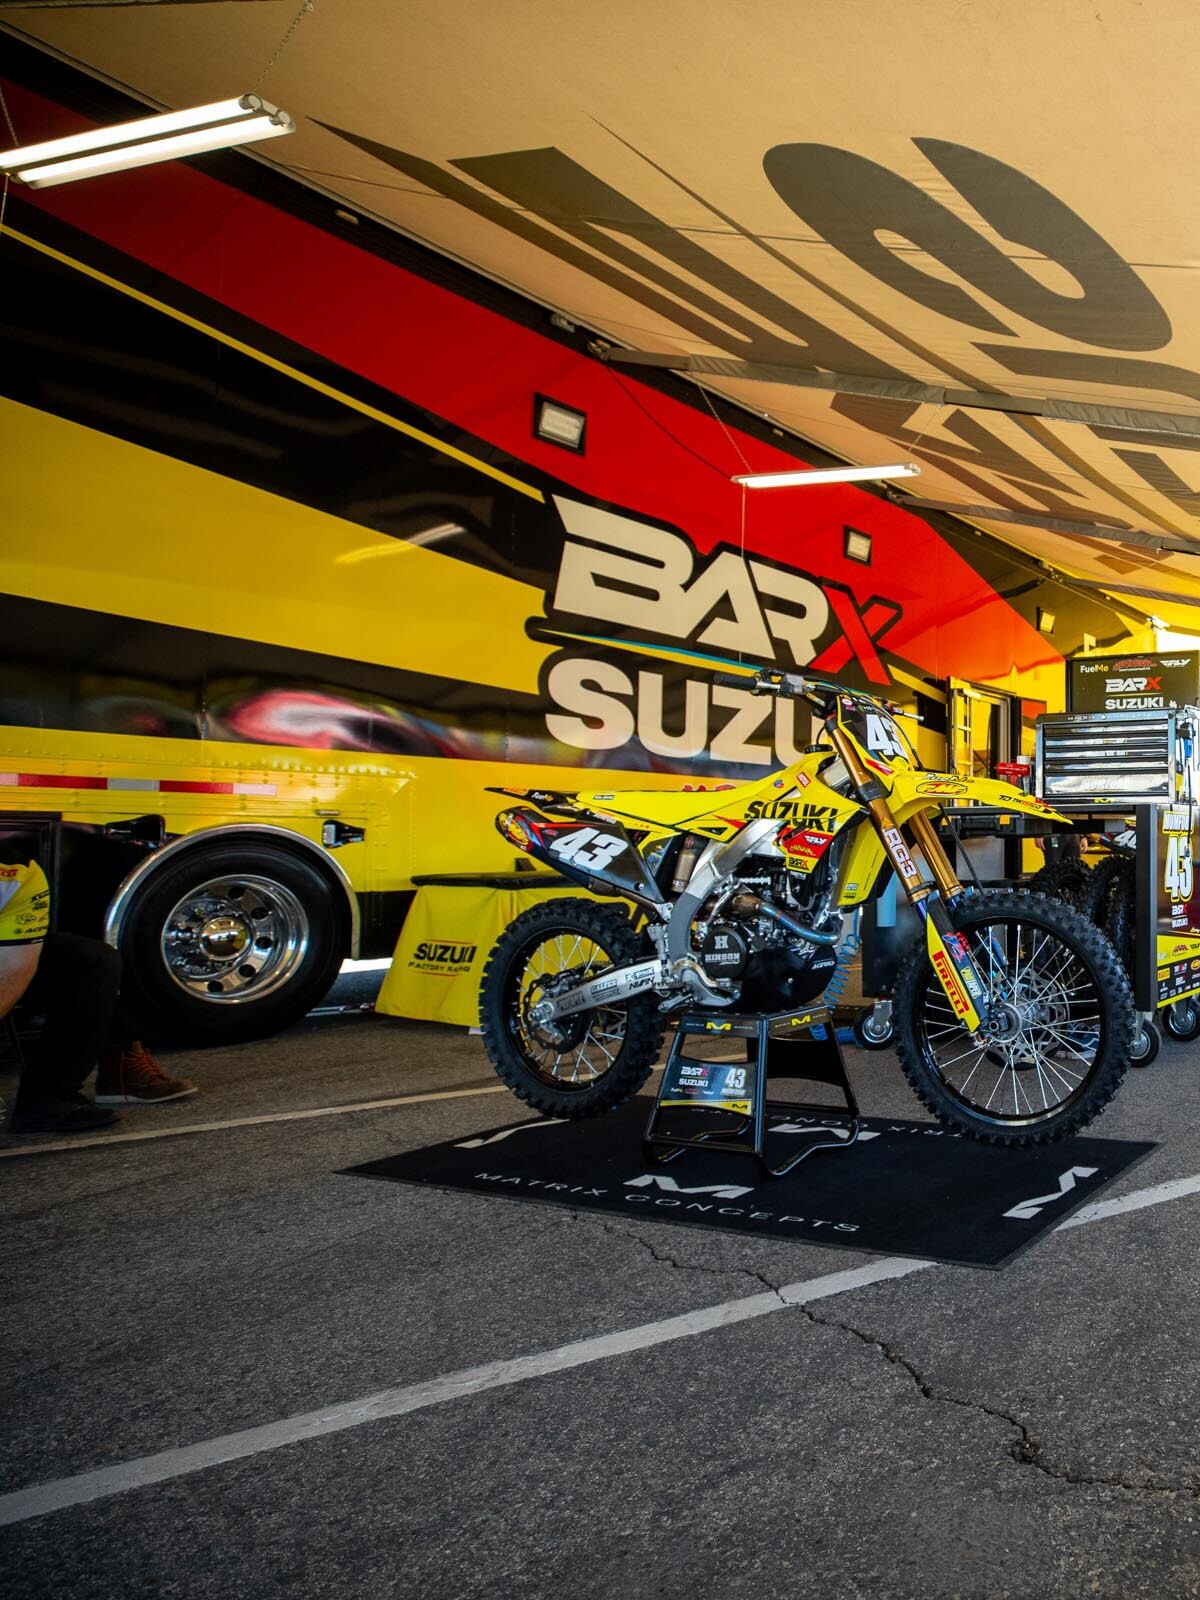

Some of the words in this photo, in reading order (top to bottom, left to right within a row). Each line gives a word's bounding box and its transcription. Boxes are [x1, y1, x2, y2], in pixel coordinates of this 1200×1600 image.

[551, 494, 902, 687] BARX
[1080, 664, 1109, 673] FuelMe
[1105, 676, 1163, 692] BARX
[1105, 697, 1163, 710] SUZUKI
[744, 800, 838, 833] SUZUKI
[550, 827, 628, 871] 43
[882, 827, 917, 879] RG3
[1165, 834, 1192, 899] 43
[705, 953, 740, 963] HINSON
[932, 950, 970, 1015] PIRELLI
[679, 1078, 709, 1087] SUZUKI
[681, 1066, 710, 1076] BARX
[725, 1067, 747, 1088] 43
[475, 1172, 608, 1196] MATRIX
[624, 1195, 861, 1232] CONCEPTS
